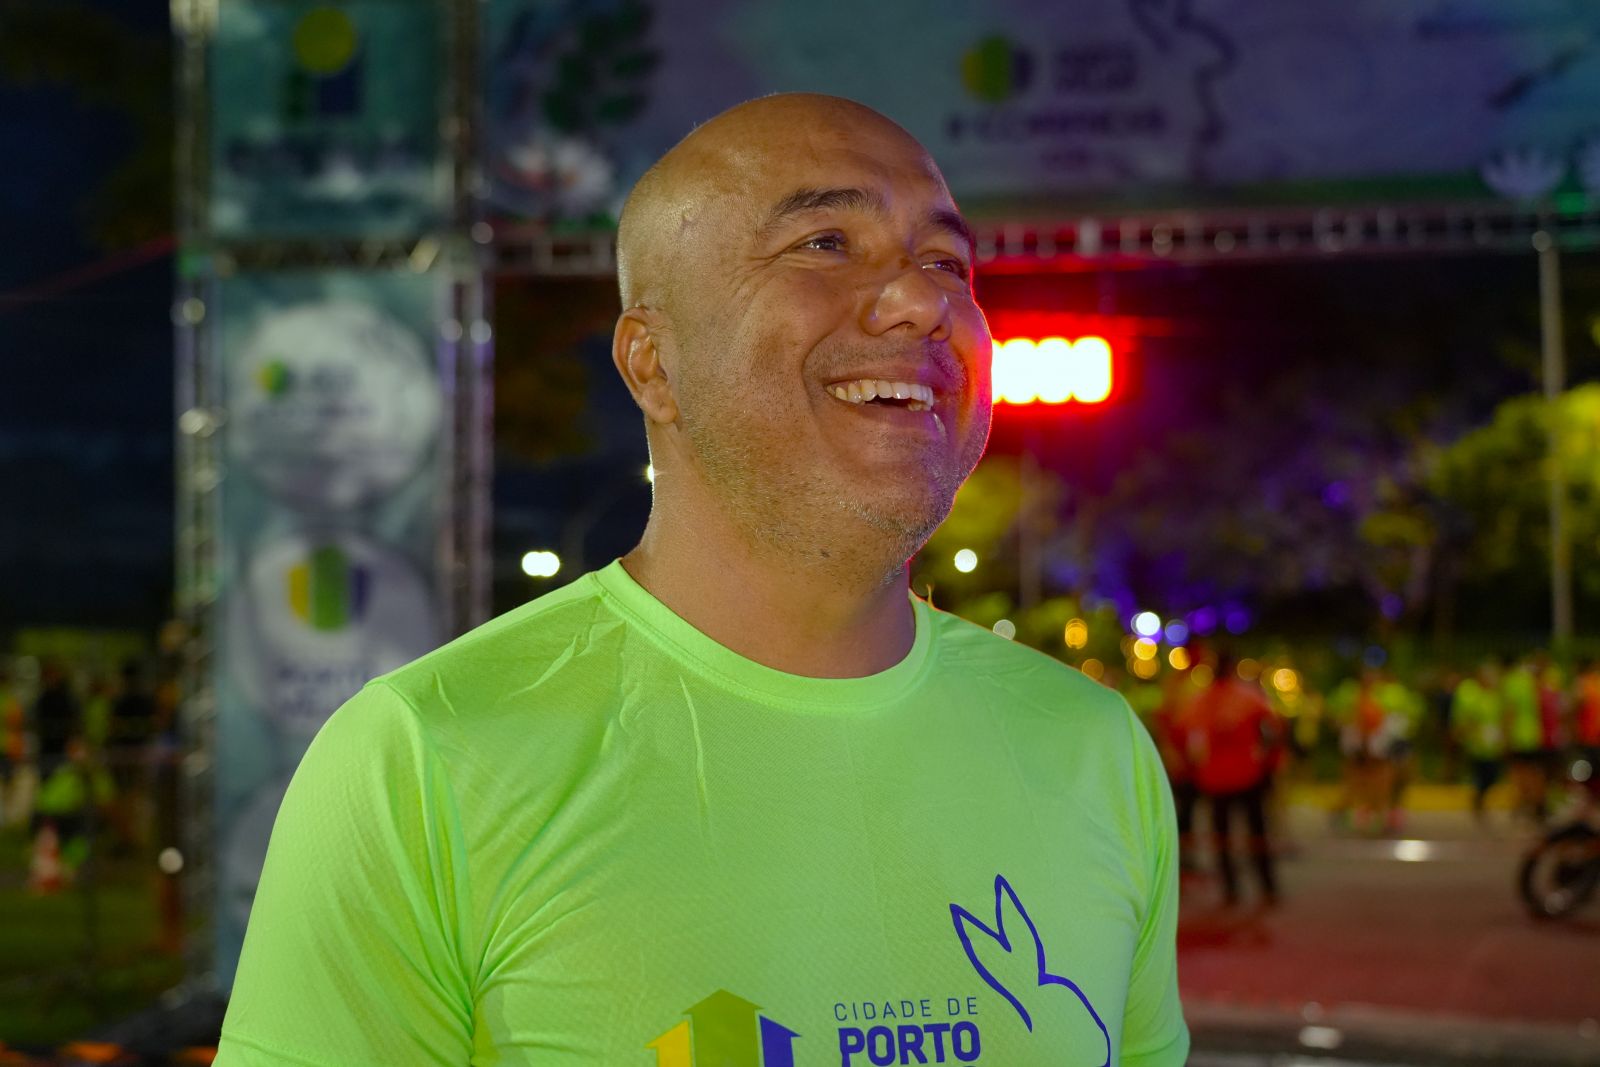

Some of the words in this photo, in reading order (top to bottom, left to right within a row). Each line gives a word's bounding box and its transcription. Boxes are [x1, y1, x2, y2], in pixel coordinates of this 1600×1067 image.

[834, 999, 932, 1021] CIDADE
[947, 997, 978, 1015] DE
[839, 1021, 981, 1067] PORTO
